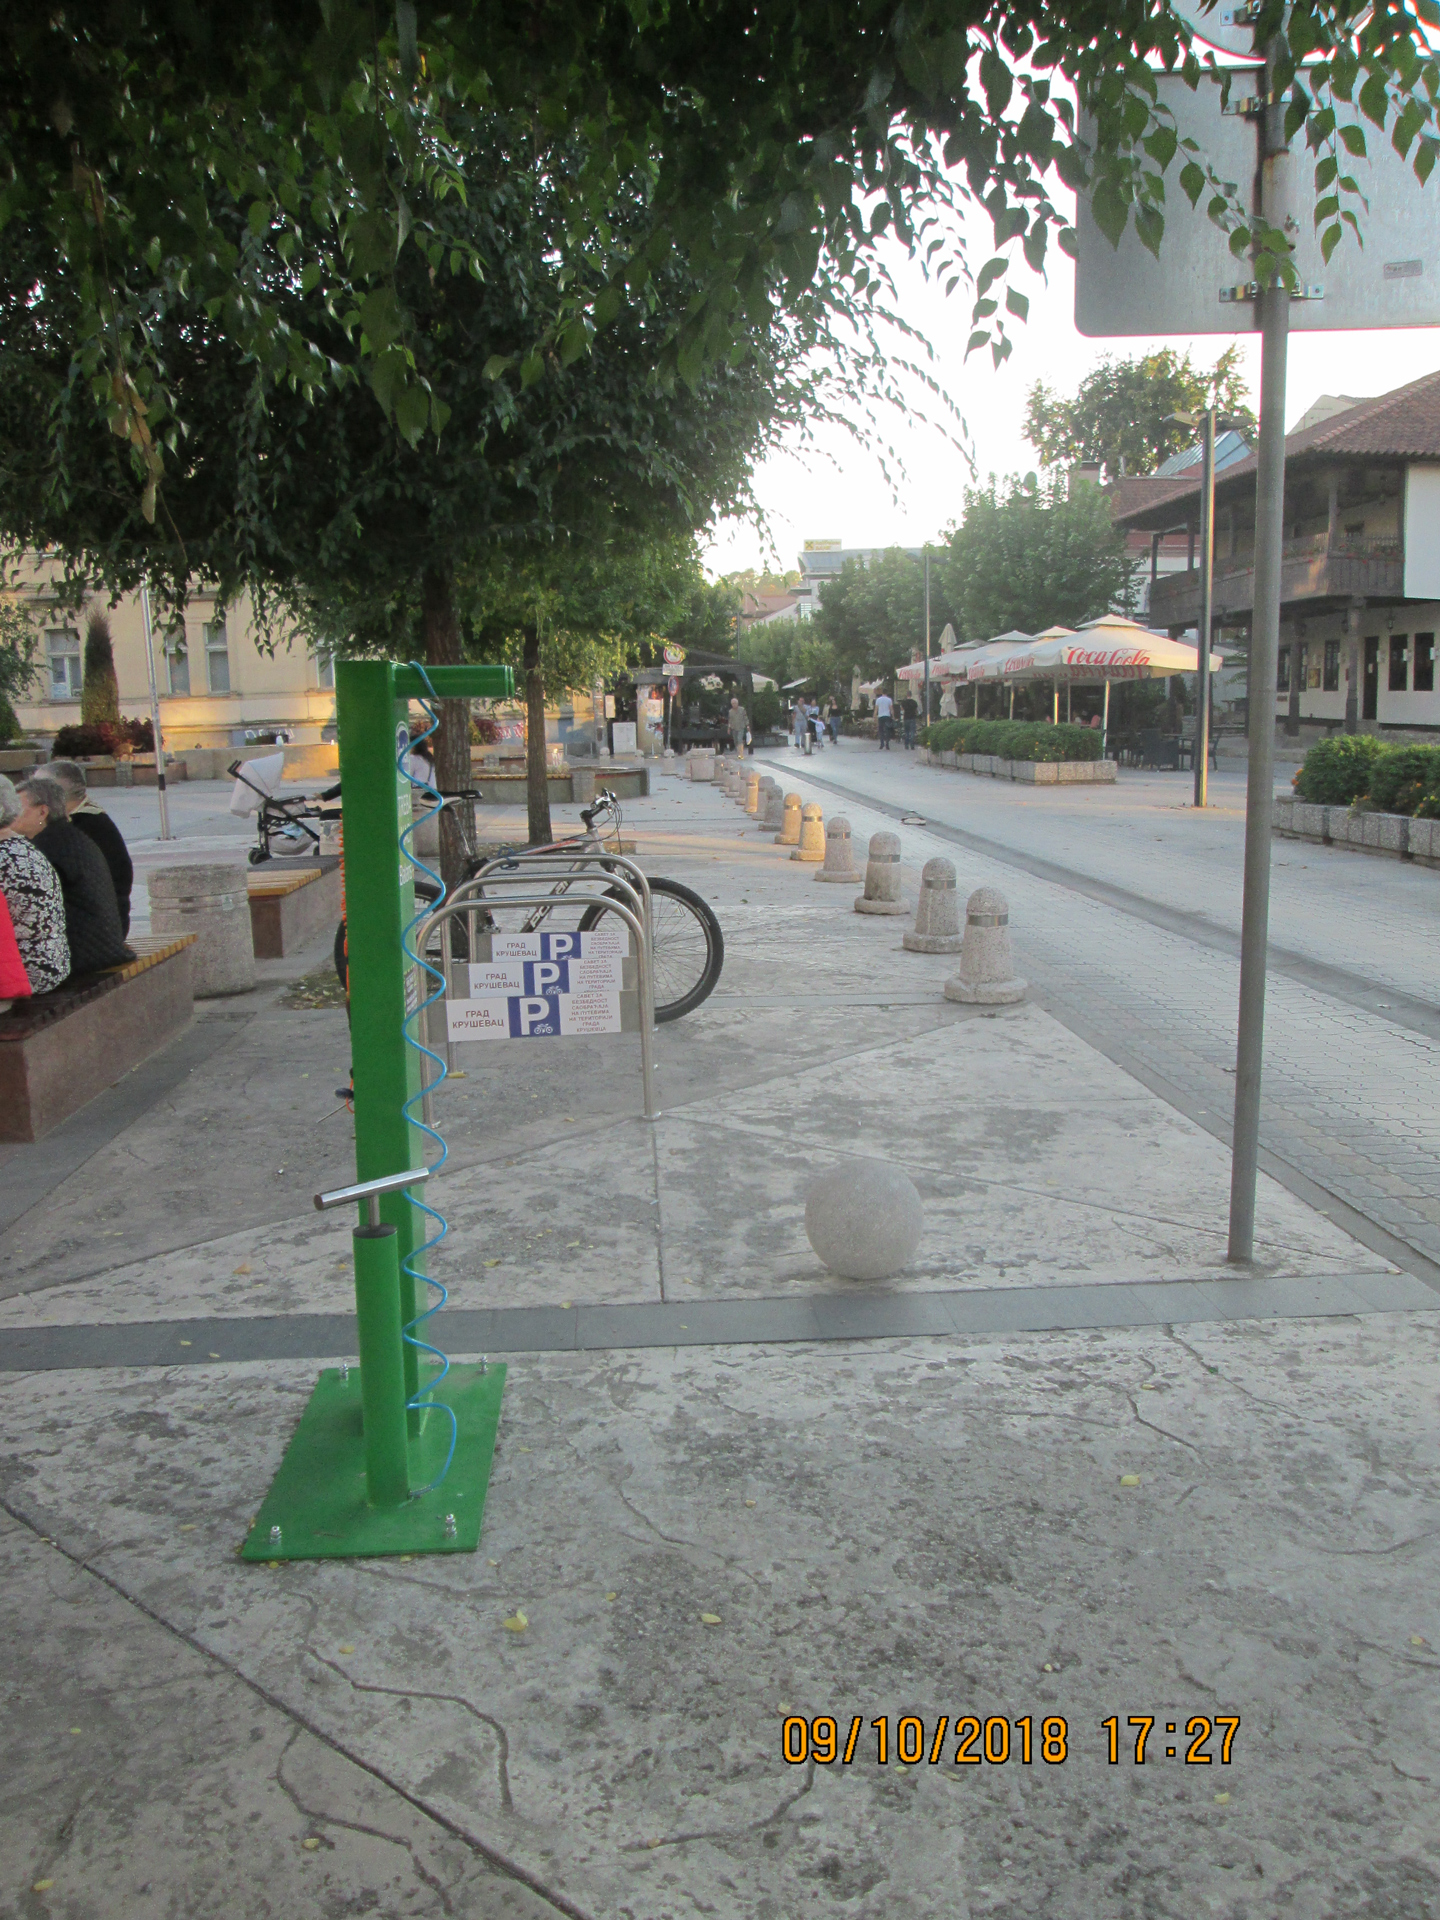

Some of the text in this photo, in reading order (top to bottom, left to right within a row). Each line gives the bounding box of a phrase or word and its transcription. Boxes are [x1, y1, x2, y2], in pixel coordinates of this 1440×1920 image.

[549, 934, 573, 960] P
[474, 981, 519, 990] КРУШЕВАЦ
[533, 962, 560, 995] P
[465, 1010, 490, 1018] ГРАД
[519, 997, 550, 1035] P
[452, 1019, 504, 1029] КРУШЕВАЦ
